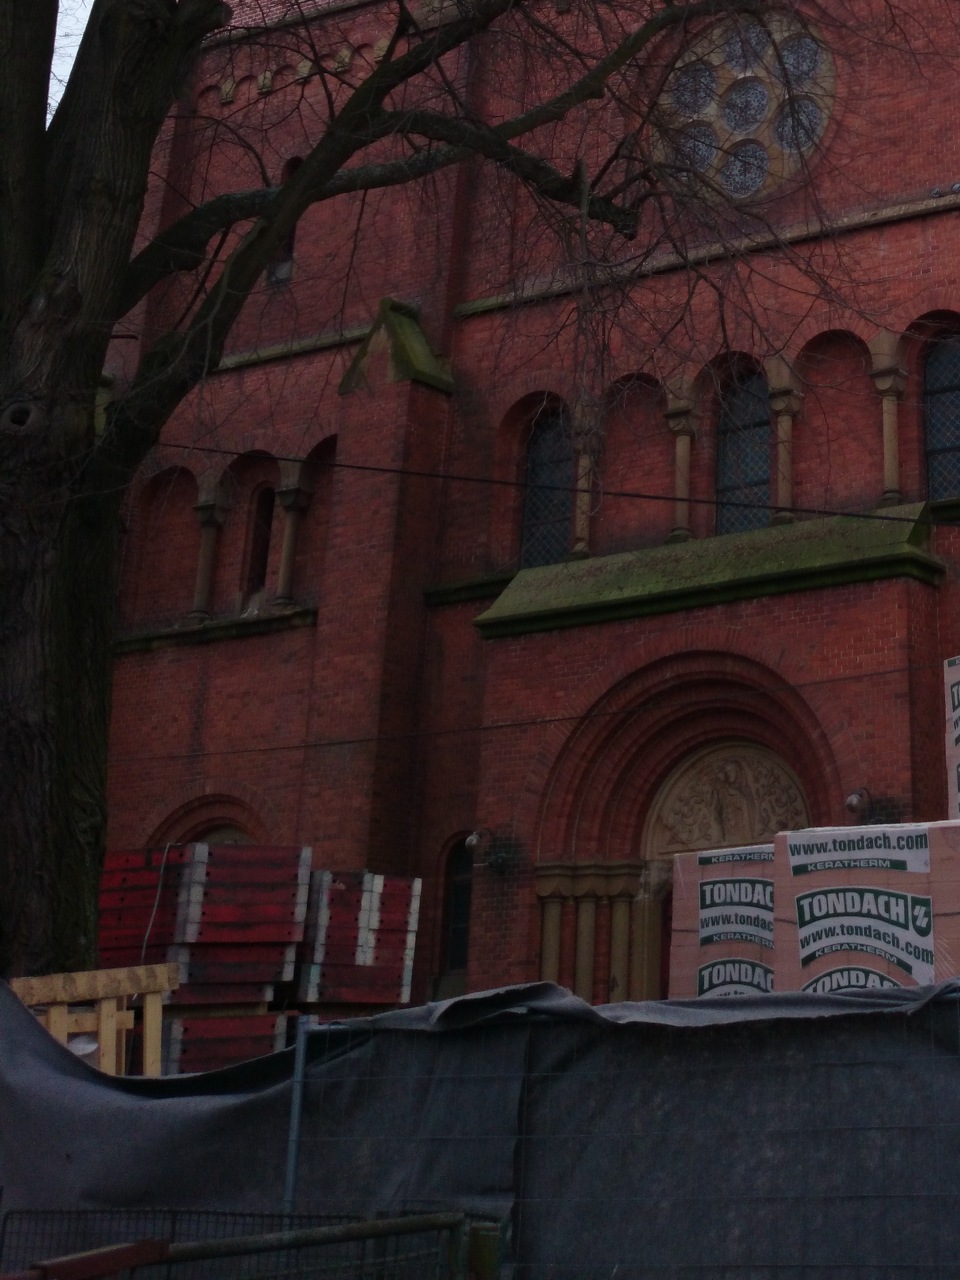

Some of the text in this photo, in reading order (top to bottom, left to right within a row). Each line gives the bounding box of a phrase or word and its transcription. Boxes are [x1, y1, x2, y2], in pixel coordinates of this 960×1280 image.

[789, 833, 929, 857] www.tondach.com
[808, 858, 891, 871] KERATHERM
[800, 891, 906, 925] TONDACH
[799, 923, 935, 966] www.tondach.com
[815, 943, 898, 964] KERATHERM
